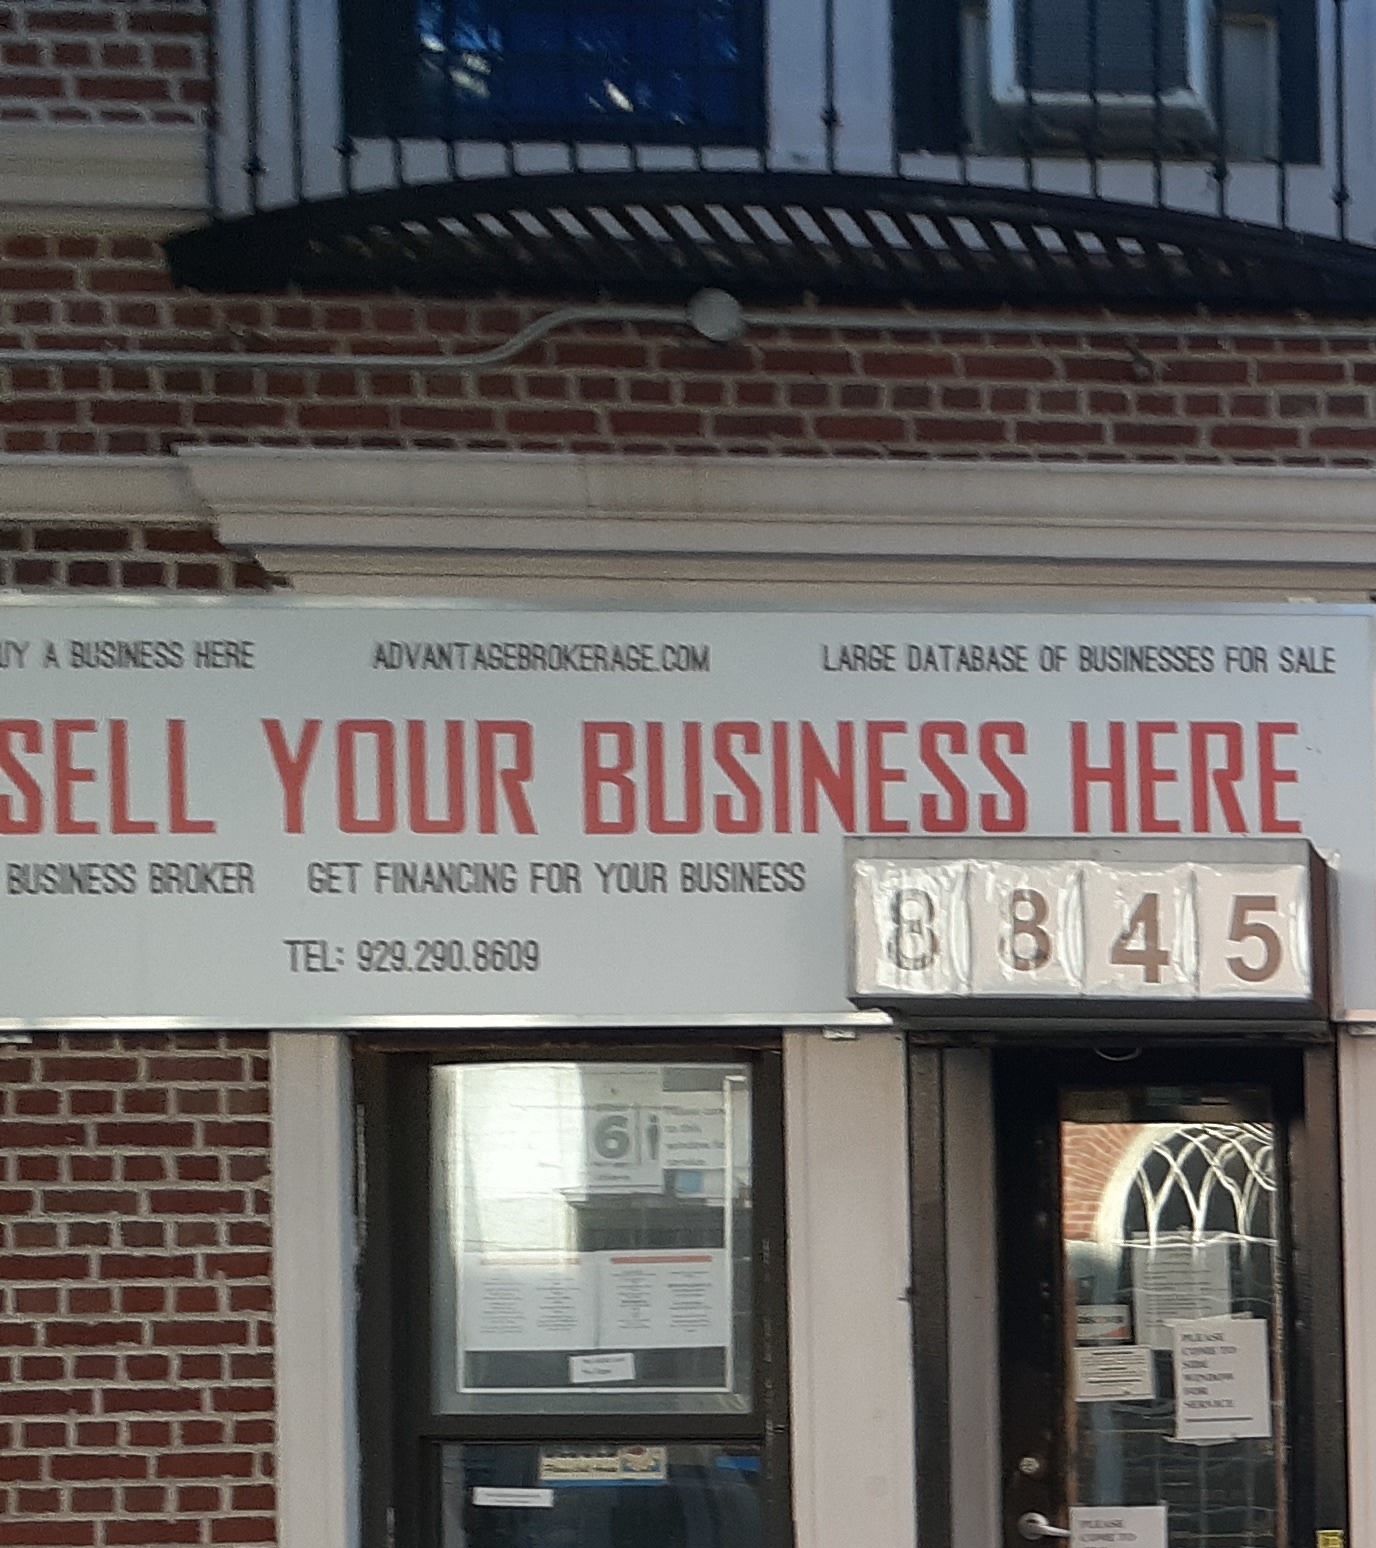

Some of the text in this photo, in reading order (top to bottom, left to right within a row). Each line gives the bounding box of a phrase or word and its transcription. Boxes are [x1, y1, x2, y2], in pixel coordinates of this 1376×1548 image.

[44, 642, 60, 668] A
[70, 641, 184, 668] BUSINESS
[194, 640, 254, 668] HERE
[373, 642, 709, 671] ADVANTAGEBROKERAGE.COM
[823, 644, 1335, 673] LARGE DATABASE OF BUSINESSES FOR SALE
[0, 719, 1300, 838] SELL YOUR BUSINESS HERE
[7, 862, 254, 895] BUSINESS BROKER
[308, 862, 805, 893] GET FINANCING FOR YOUR BUSINESS
[283, 940, 539, 972] TEL: 929.290.8609
